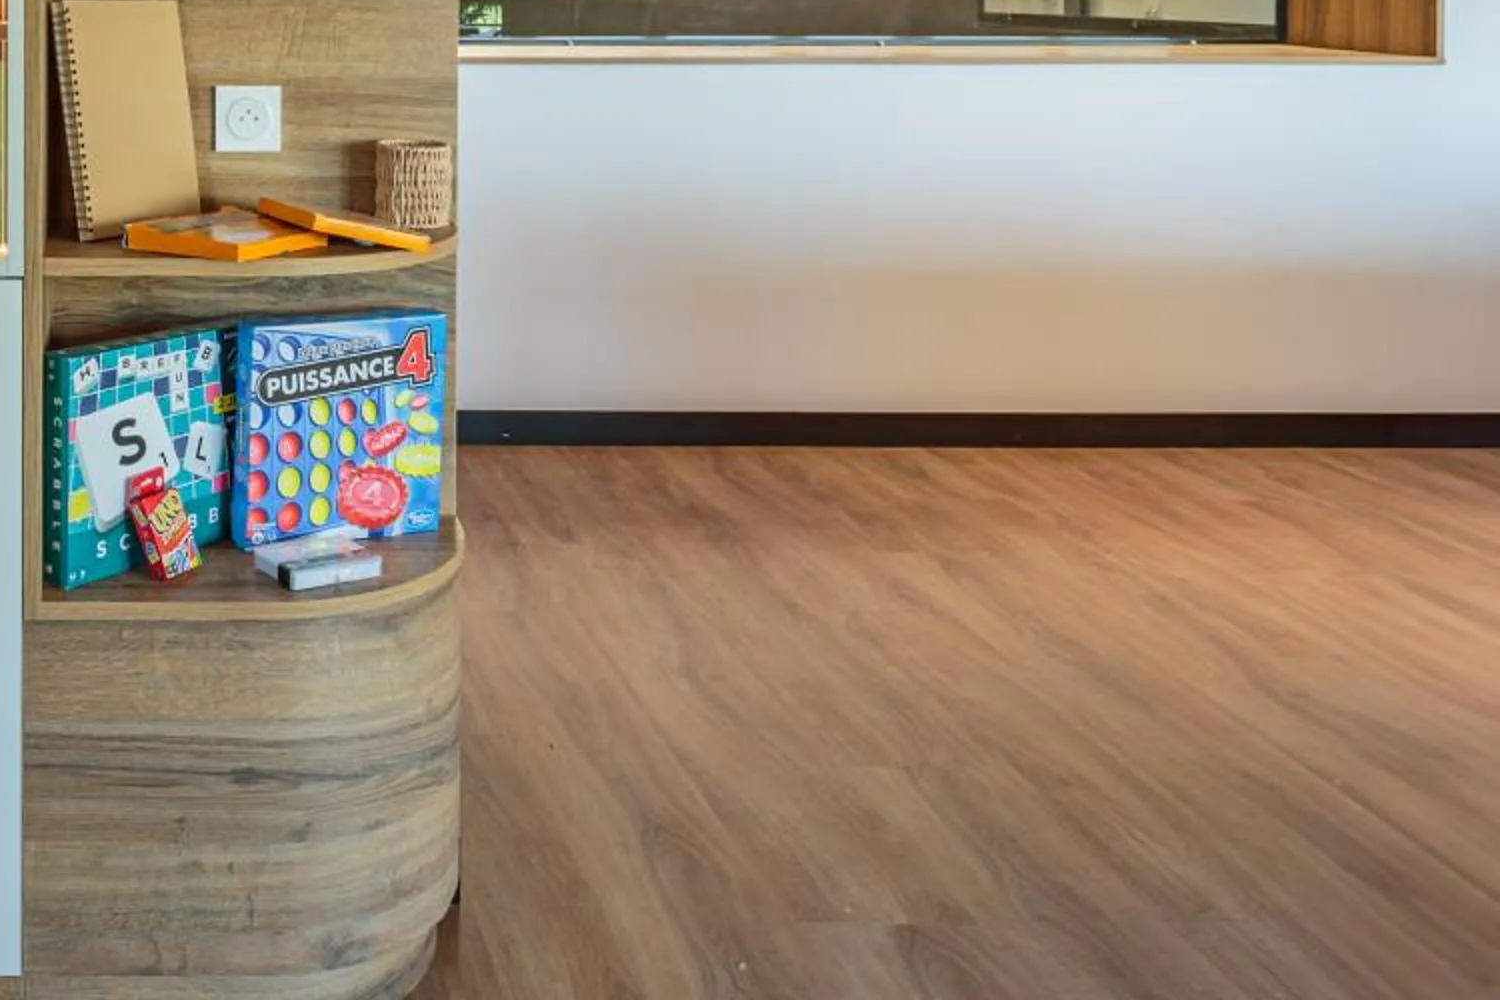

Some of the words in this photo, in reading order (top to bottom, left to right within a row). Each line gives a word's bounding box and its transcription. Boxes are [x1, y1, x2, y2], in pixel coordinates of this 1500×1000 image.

[266, 357, 395, 399] PUISSANCE
[396, 329, 432, 382] 4
[111, 417, 147, 466] S
[195, 437, 207, 461] L
[363, 480, 383, 507] 4
